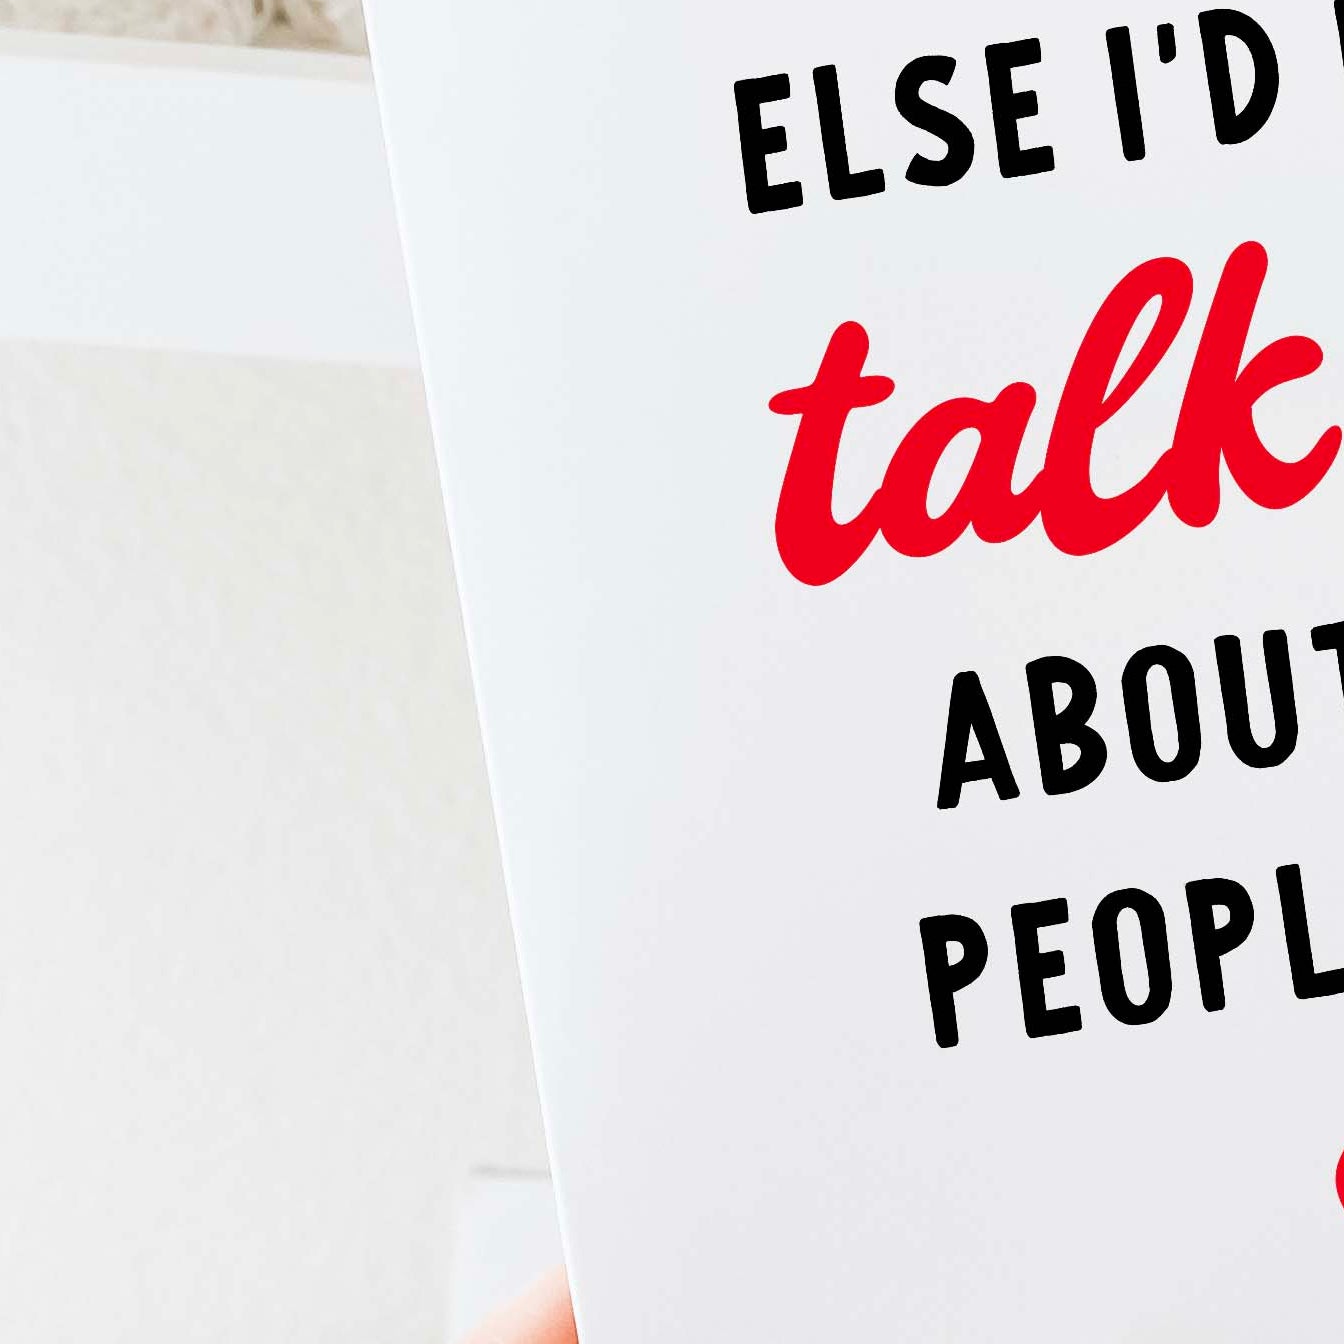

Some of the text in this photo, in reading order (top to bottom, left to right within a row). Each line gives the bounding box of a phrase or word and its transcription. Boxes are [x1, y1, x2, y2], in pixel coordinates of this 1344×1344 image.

[733, 37, 1056, 215] ELSE
[1105, 8, 1280, 162] I'D
[768, 240, 1343, 587] talk
